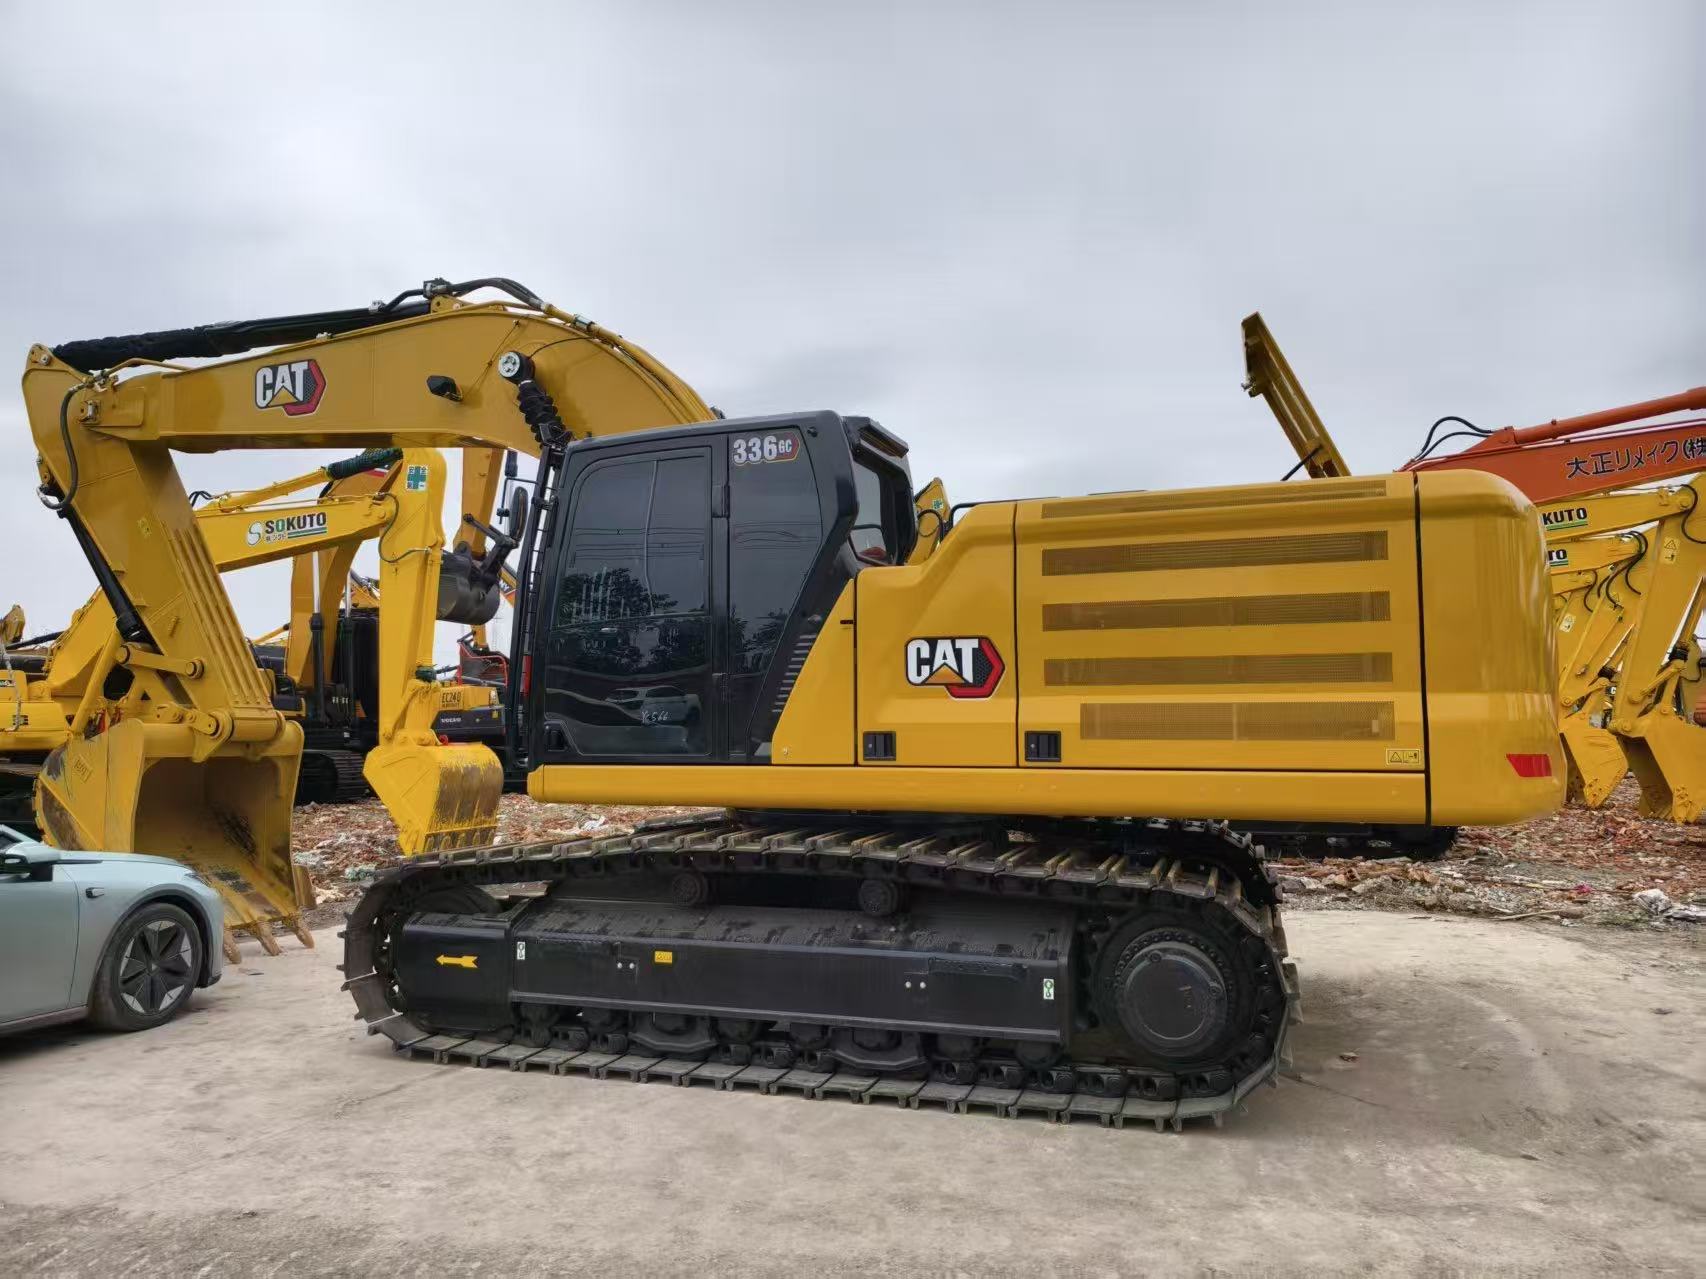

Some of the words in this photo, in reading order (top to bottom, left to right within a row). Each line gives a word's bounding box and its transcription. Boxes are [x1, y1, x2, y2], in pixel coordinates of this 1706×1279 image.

[255, 361, 309, 408] CAT
[733, 435, 778, 464] 336
[778, 439, 793, 454] GC
[265, 511, 327, 534] SOKUTO
[906, 638, 979, 685] CAT
